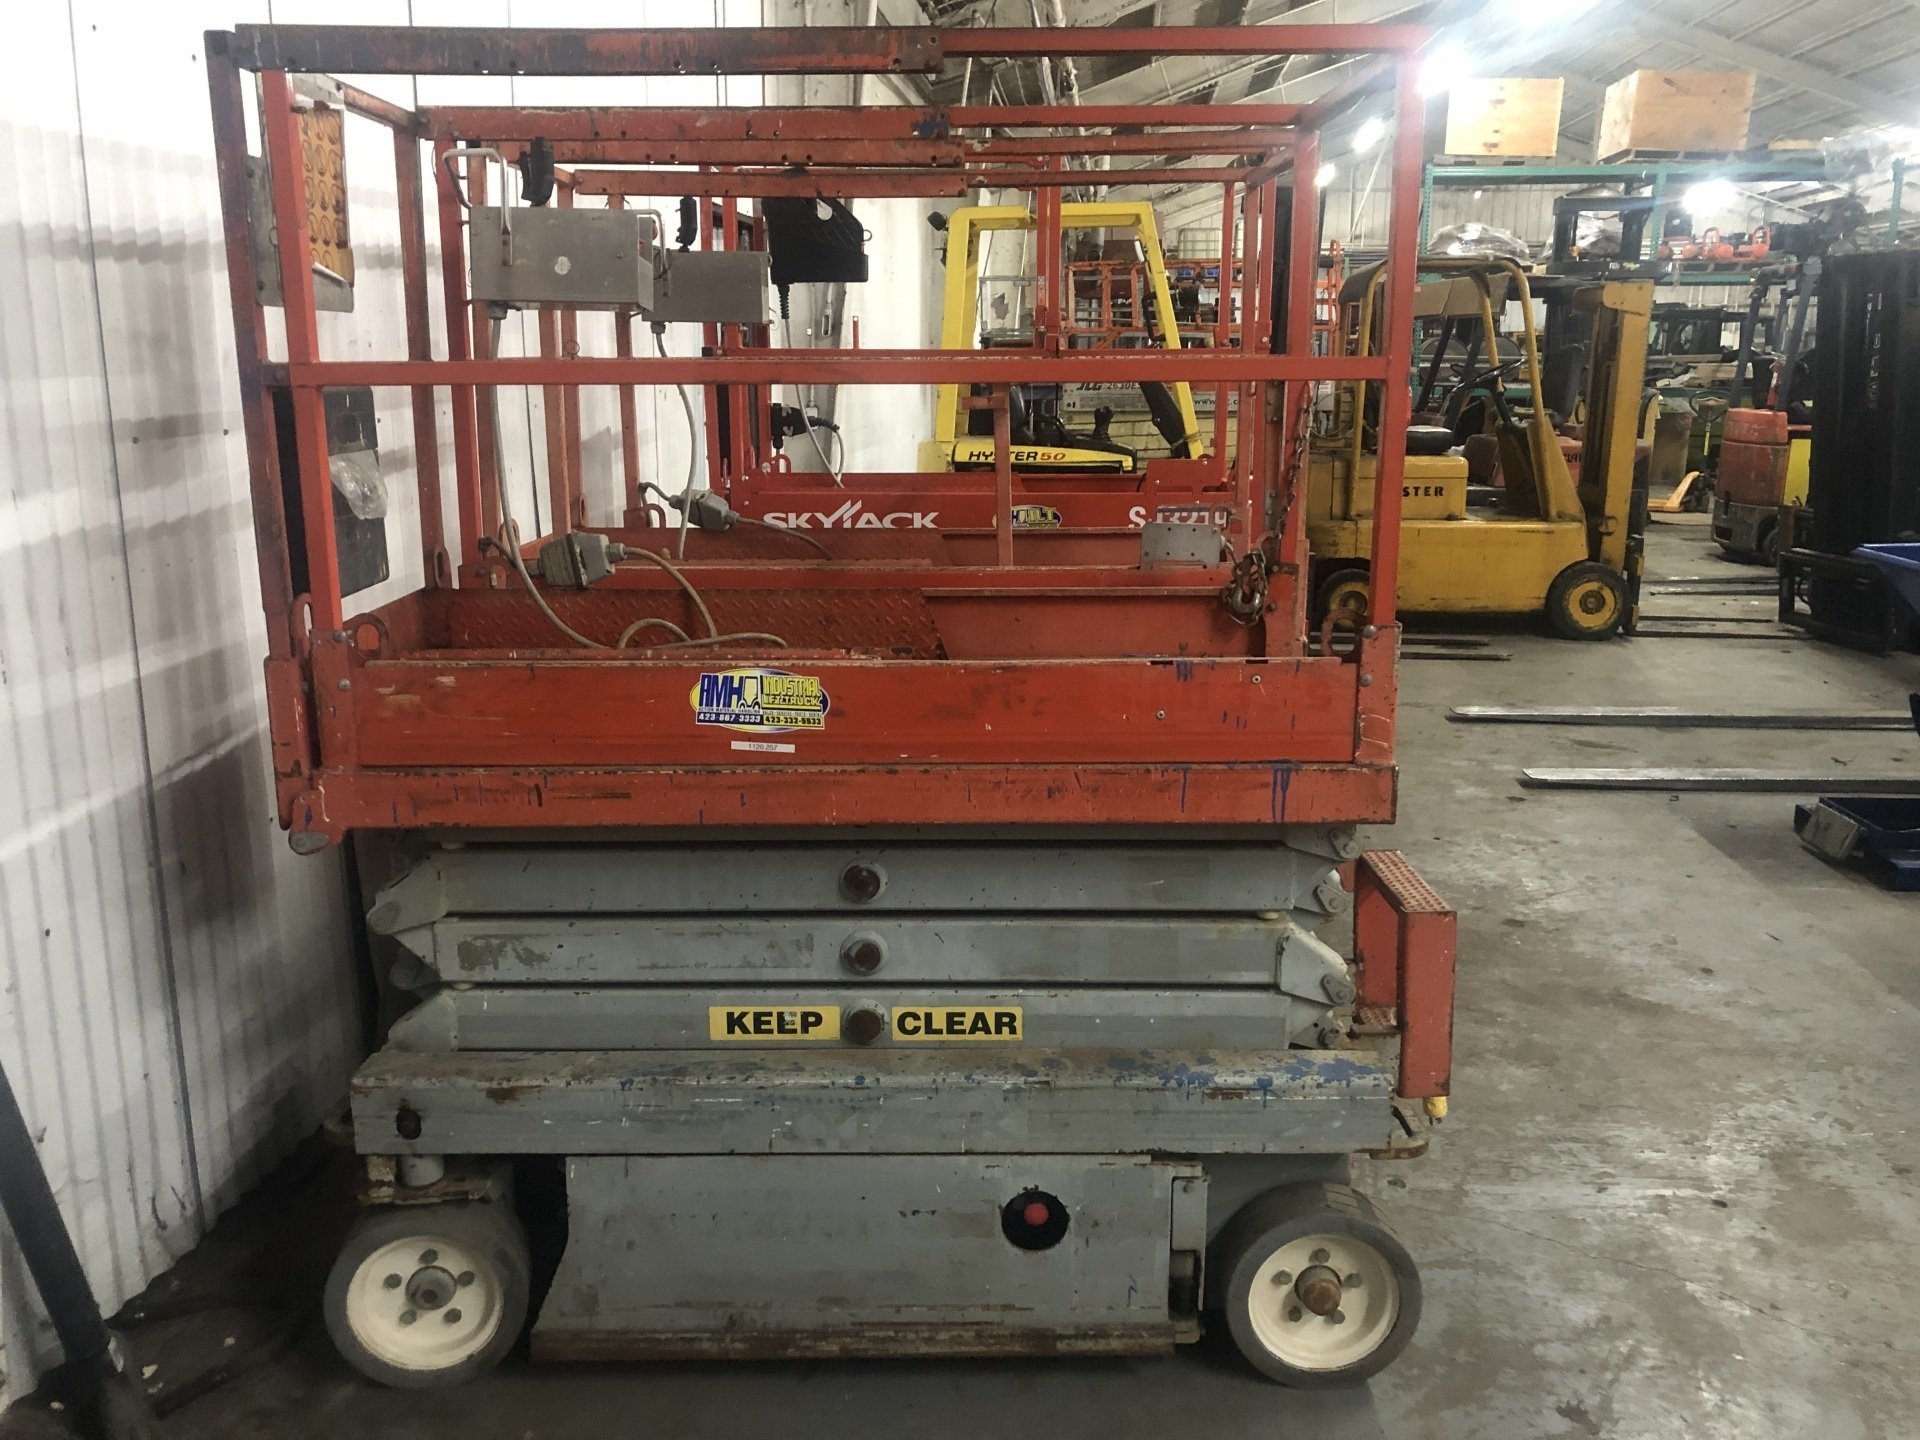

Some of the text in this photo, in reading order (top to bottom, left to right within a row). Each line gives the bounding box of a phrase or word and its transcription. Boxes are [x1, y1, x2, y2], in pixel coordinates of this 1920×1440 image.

[968, 451, 1066, 461] HYTER 50
[1402, 486, 1444, 497] STER
[763, 499, 939, 528] SKYJACK
[699, 675, 744, 708] AMH
[764, 676, 820, 697] INDUSTRIAL
[726, 1011, 1017, 1035] KEEP CLEAR
